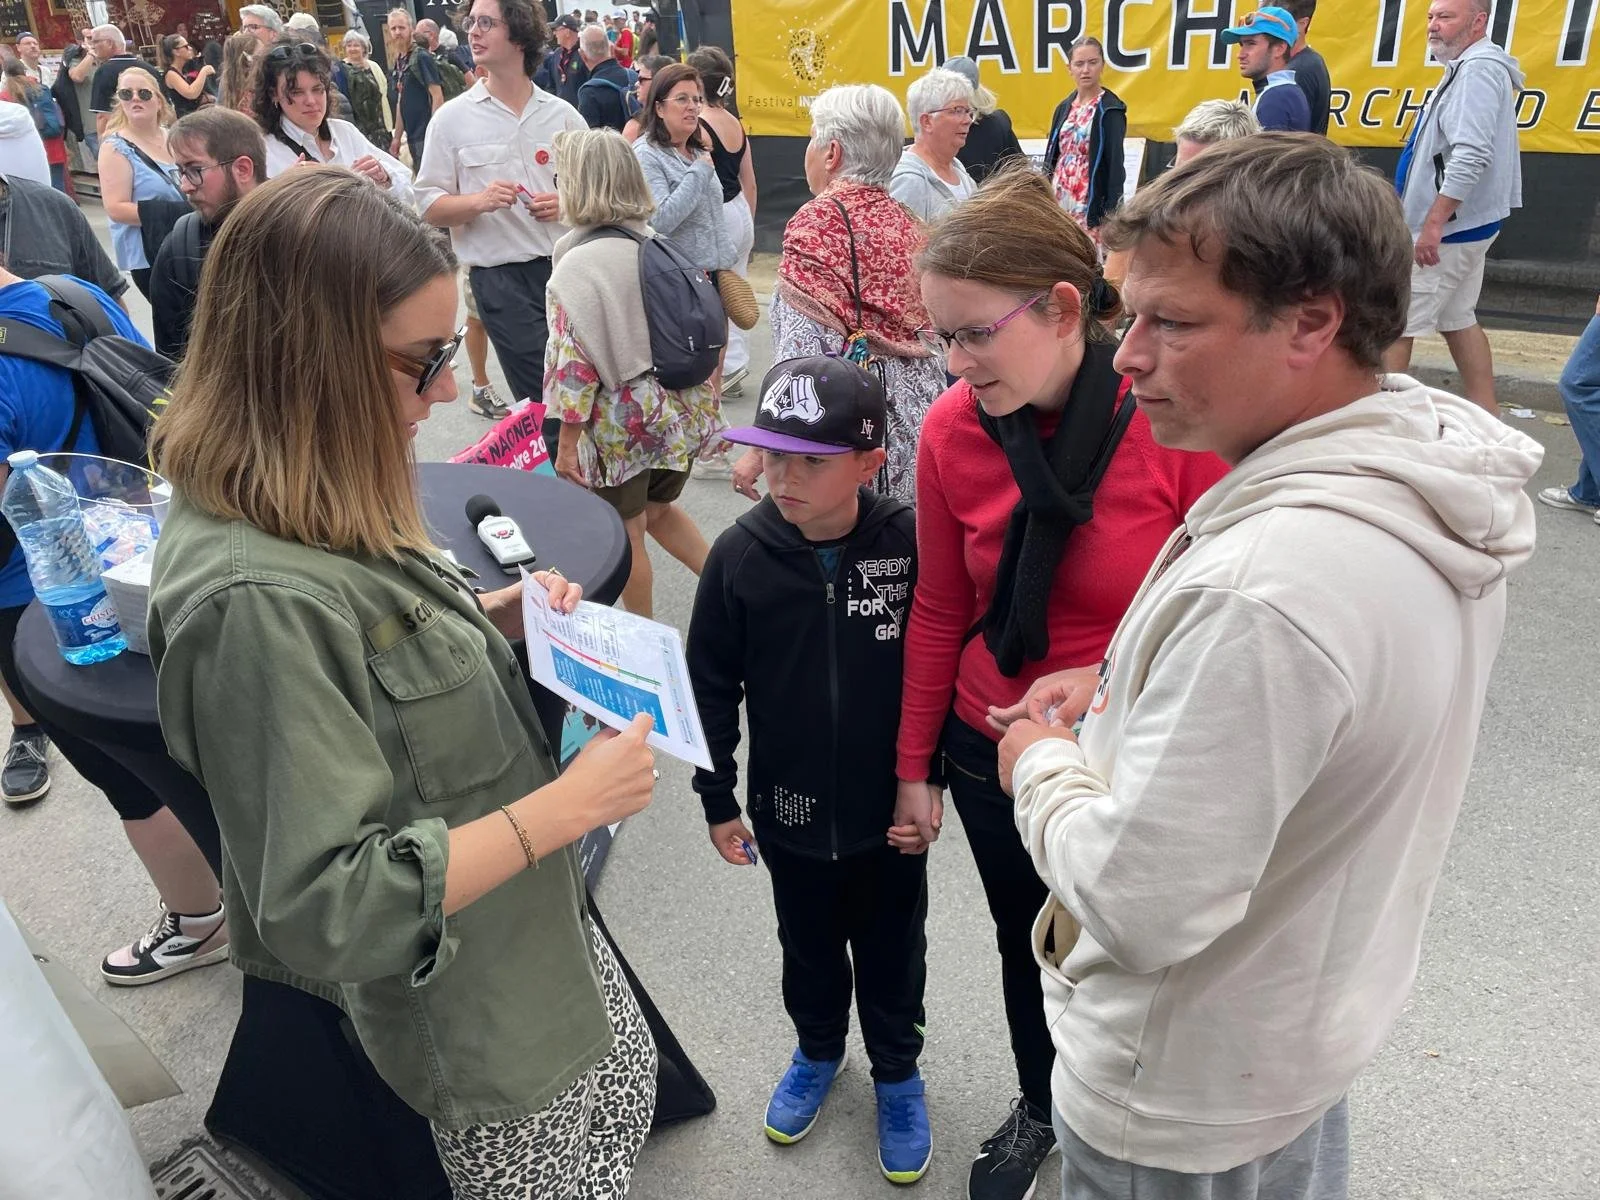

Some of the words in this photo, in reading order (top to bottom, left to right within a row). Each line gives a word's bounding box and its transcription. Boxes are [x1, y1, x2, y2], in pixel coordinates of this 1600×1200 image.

[888, 0, 1239, 77] MARCH
[748, 95, 797, 107] Festival
[877, 581, 909, 602] THE
[848, 598, 885, 617] FOR
